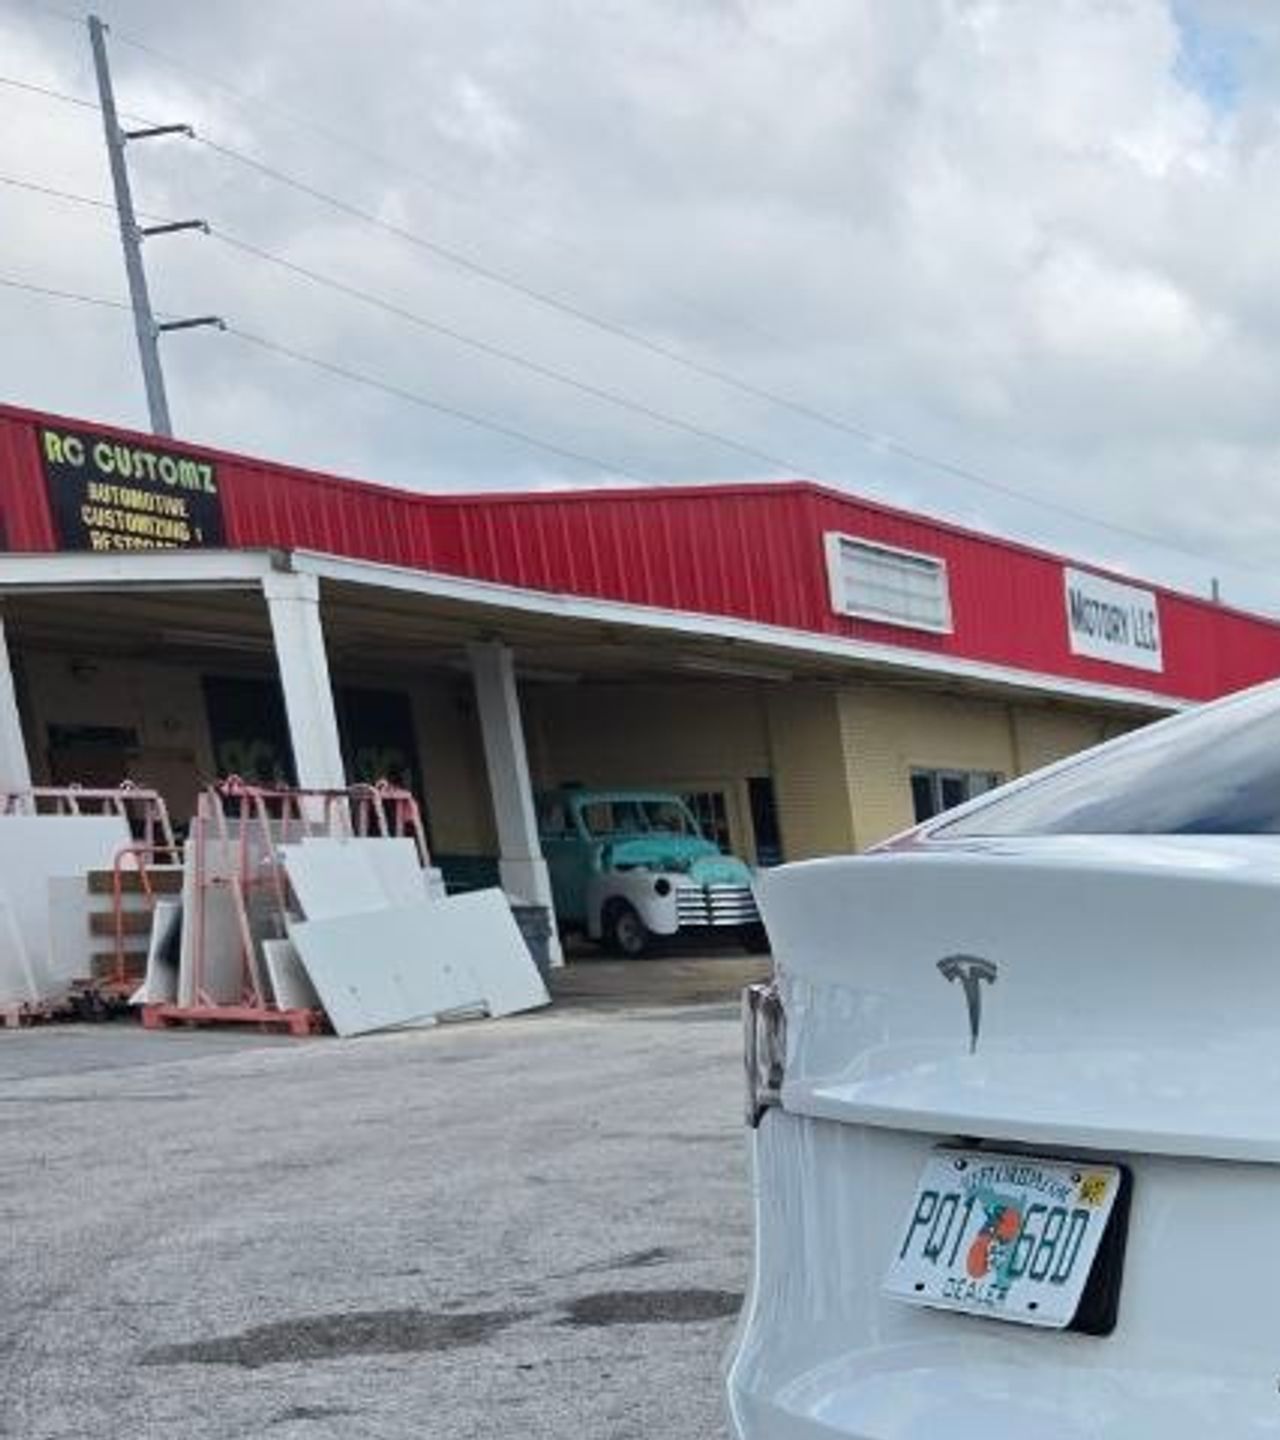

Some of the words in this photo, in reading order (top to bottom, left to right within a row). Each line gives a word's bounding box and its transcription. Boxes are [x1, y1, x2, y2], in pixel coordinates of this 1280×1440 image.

[44, 431, 86, 467] RC
[93, 443, 218, 494] CUSTOMZ
[88, 481, 190, 519] AUTOMOTIVE
[81, 504, 192, 542] CUSTOMIZING
[943, 1277, 1011, 1306] DEALER
